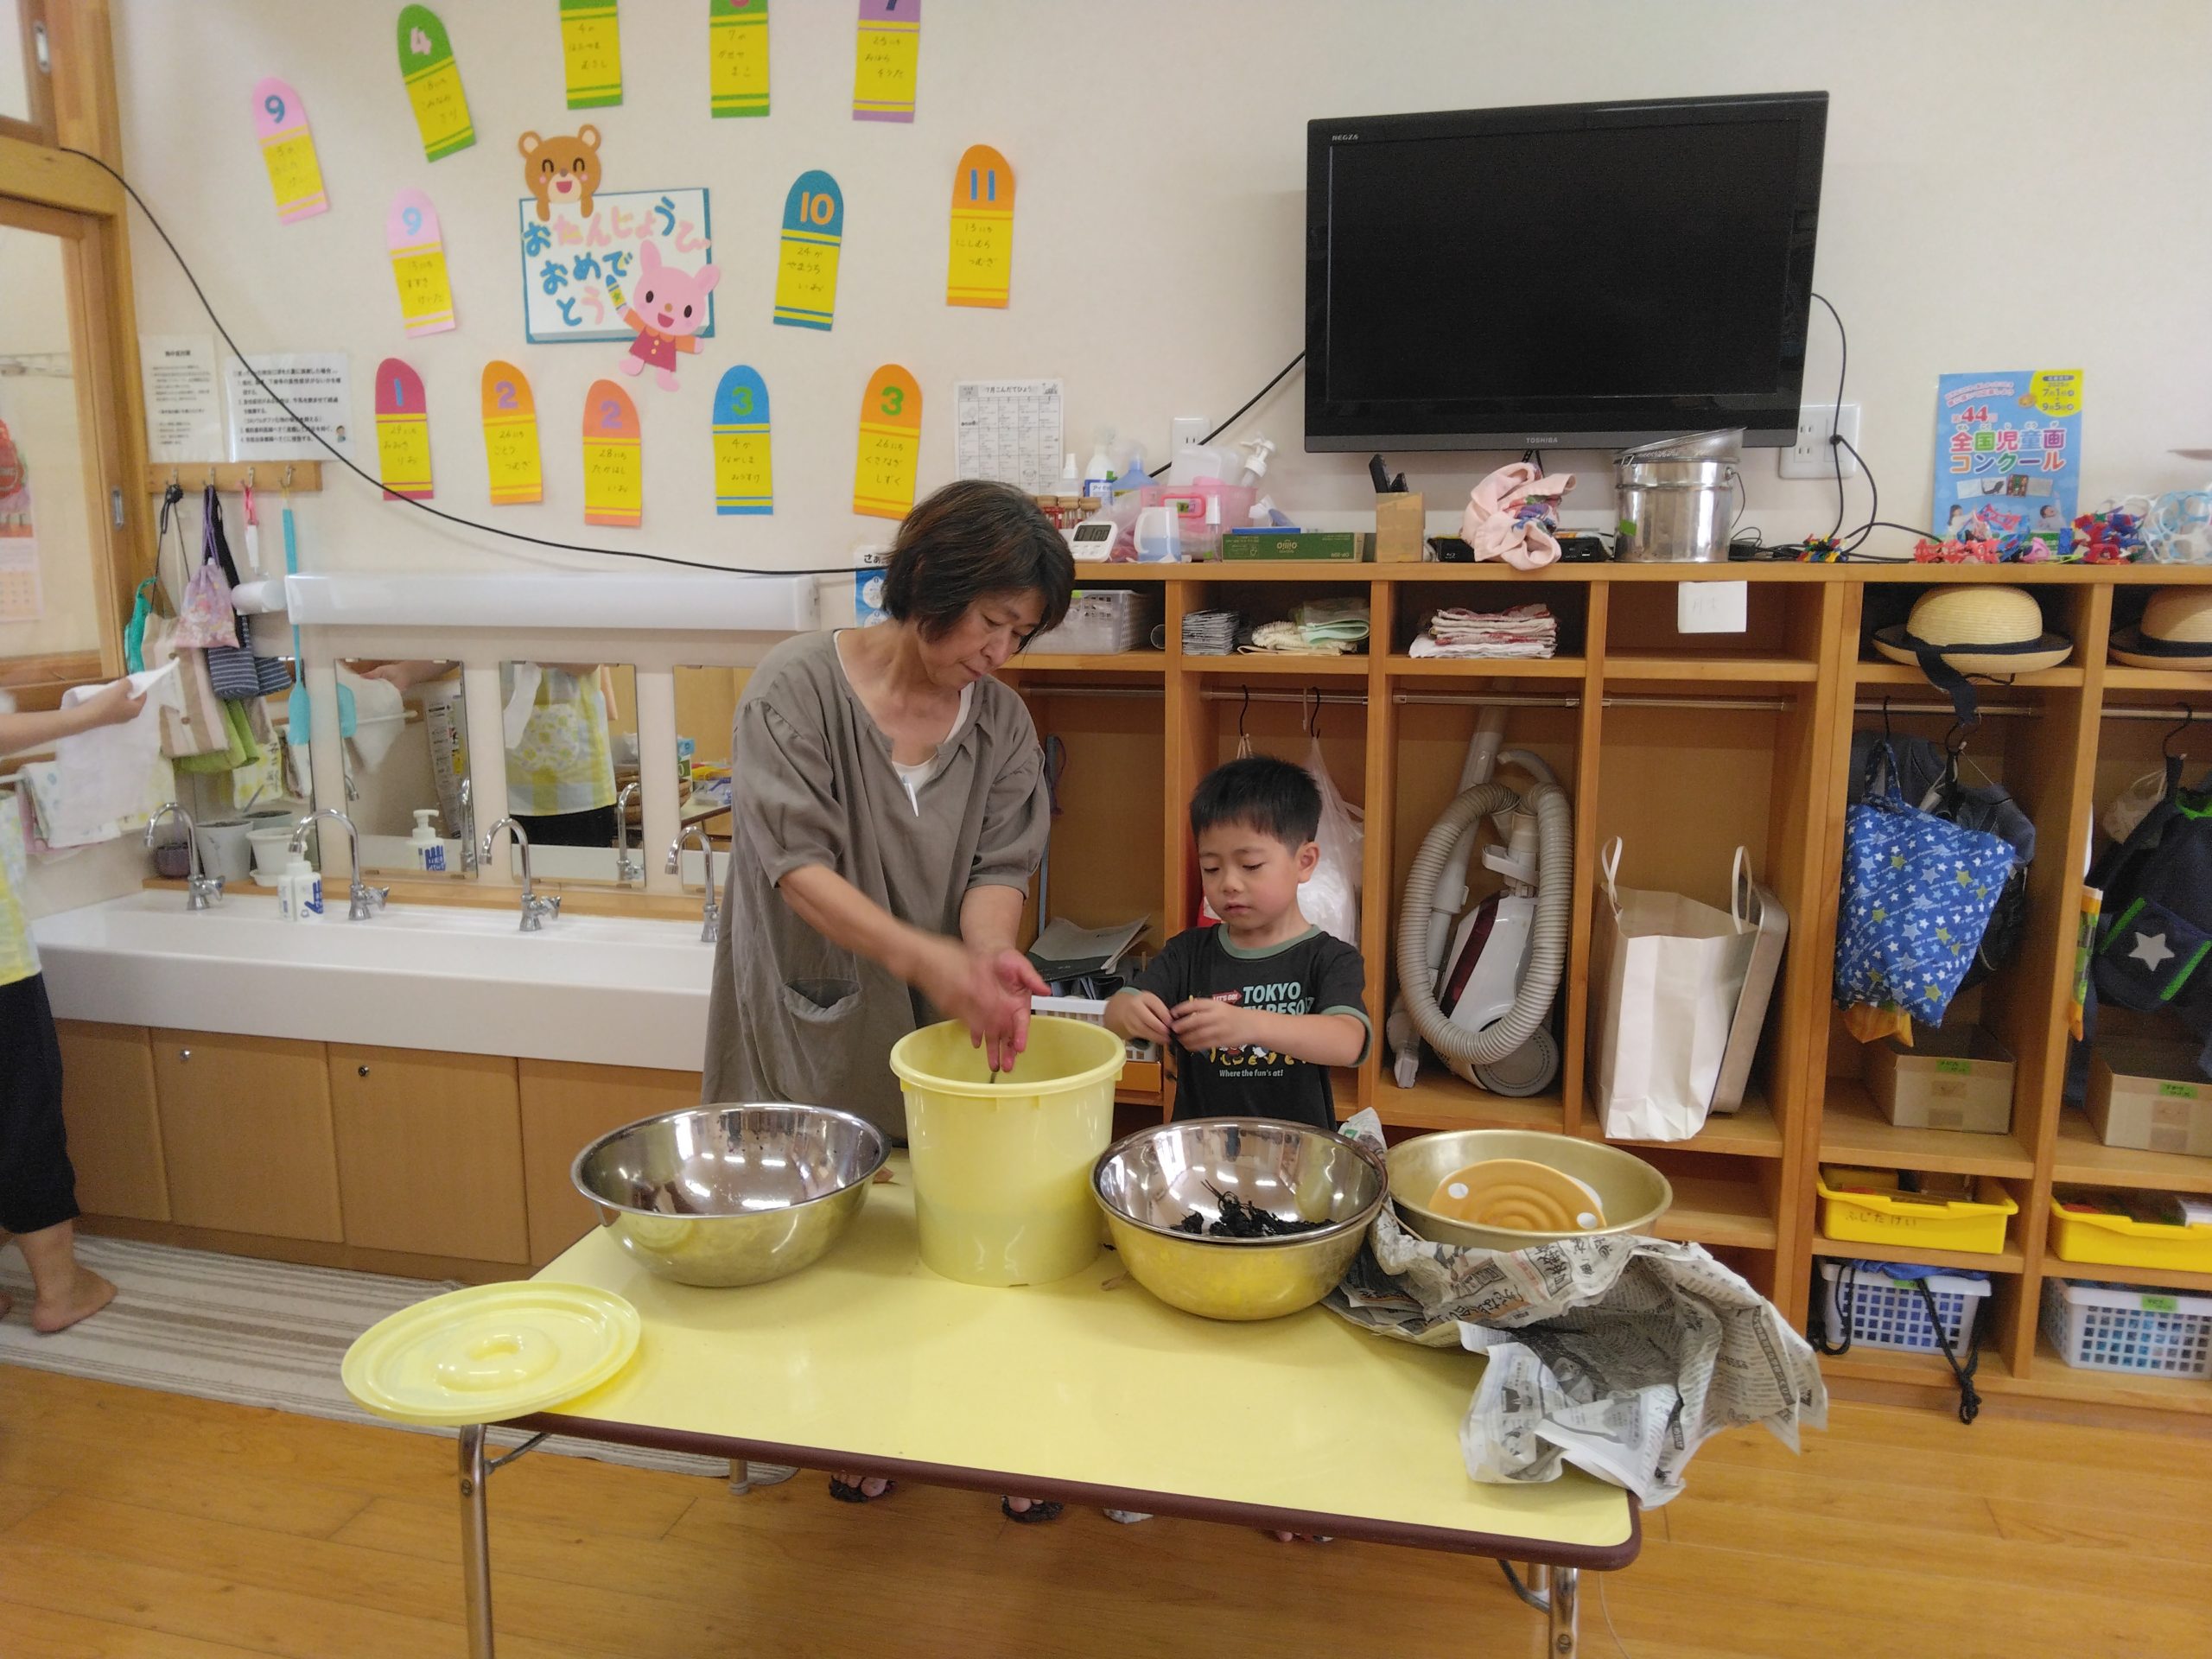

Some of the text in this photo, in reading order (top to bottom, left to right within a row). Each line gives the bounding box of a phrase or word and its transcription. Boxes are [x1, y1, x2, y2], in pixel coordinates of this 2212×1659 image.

[410, 27, 431, 55] 4
[264, 95, 285, 124] 9
[969, 168, 995, 201] 11
[402, 207, 423, 236] 9
[800, 191, 835, 226] 10
[539, 251, 632, 296] おめで
[556, 286, 605, 327] とう
[393, 378, 403, 407] 1
[495, 381, 518, 409] 2
[733, 386, 753, 416] 3
[881, 386, 904, 416] 3
[601, 401, 623, 429] 2
[1951, 429, 2065, 453] 全国児童画
[1950, 451, 2064, 474] コンクール
[1243, 982, 1301, 1004] TOKYO
[1254, 1069, 1272, 1077] fun's
